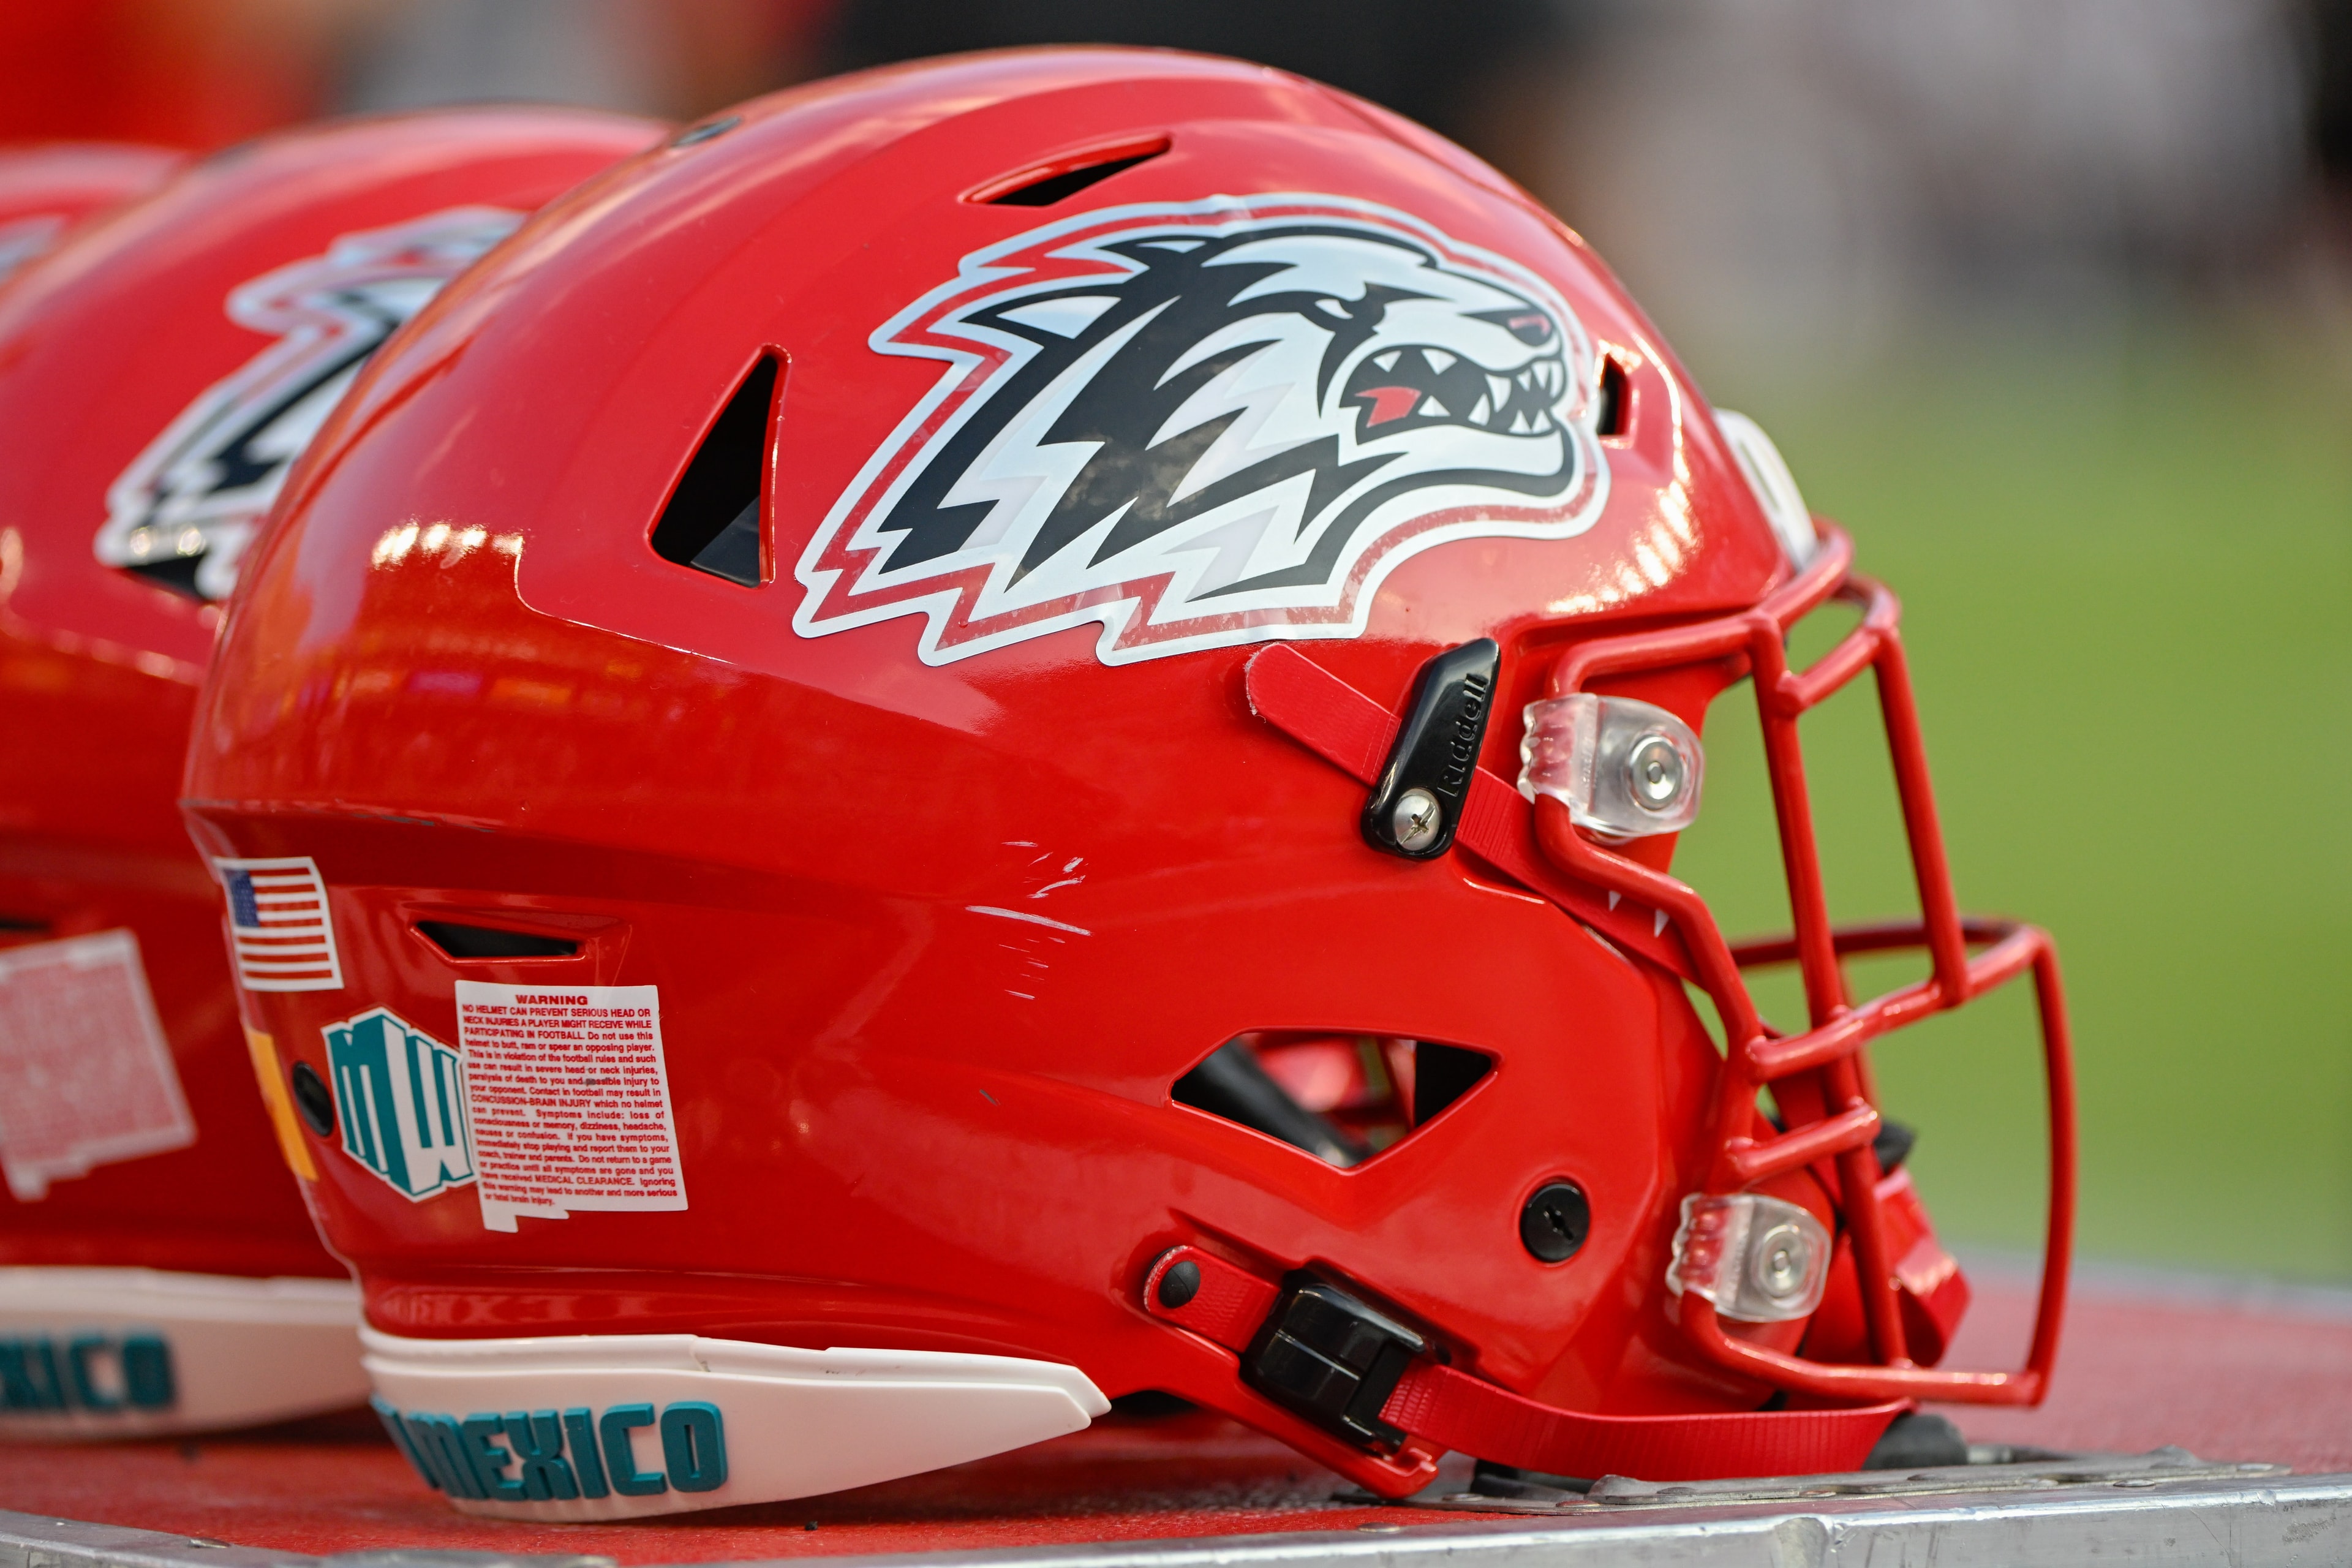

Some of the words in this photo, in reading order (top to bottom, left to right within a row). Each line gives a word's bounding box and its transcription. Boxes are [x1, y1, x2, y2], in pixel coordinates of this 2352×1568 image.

[1437, 673, 1489, 797] Riddell
[516, 995, 588, 1005] WARNING
[476, 1005, 507, 1015] HELMET
[510, 1007, 527, 1016] CAN
[530, 1008, 568, 1017] PREVENT
[571, 1008, 608, 1017] SERIOUS
[611, 1009, 635, 1017] HEAD
[638, 1008, 650, 1017] OR
[464, 1016, 483, 1024] NECK
[486, 1017, 519, 1027] INJURIES
[528, 1019, 560, 1028] PLAYER
[561, 1020, 586, 1028] MIGHT
[589, 1020, 624, 1029] RECEIVE
[625, 1020, 652, 1028] WHILE
[464, 1027, 525, 1038] PARTICIPATING
[538, 1030, 585, 1040] FOOTBALL.
[587, 1031, 600, 1040] Do
[636, 1031, 654, 1040] this
[548, 1044, 571, 1052] spear
[586, 1044, 624, 1054] opposing
[627, 1044, 654, 1053] player.
[548, 1054, 561, 1062] the
[562, 1054, 593, 1063] football
[636, 1054, 656, 1063] such
[623, 1066, 658, 1076] injuries,
[572, 1088, 604, 1096] football
[606, 1090, 624, 1098] may
[626, 1088, 650, 1097] result
[559, 1099, 590, 1107] INJURY
[536, 1109, 582, 1120] Symptoms
[587, 1110, 624, 1120] include:
[630, 1111, 650, 1120] loss
[655, 1110, 665, 1119] of
[580, 1121, 620, 1130] dizziness,
[595, 1133, 617, 1142] have
[620, 1134, 668, 1143] symptoms,
[649, 1157, 672, 1166] game
[615, 1168, 636, 1177] gone
[576, 1177, 634, 1186] CLEARANCE.
[640, 1177, 676, 1188] Ignoring
